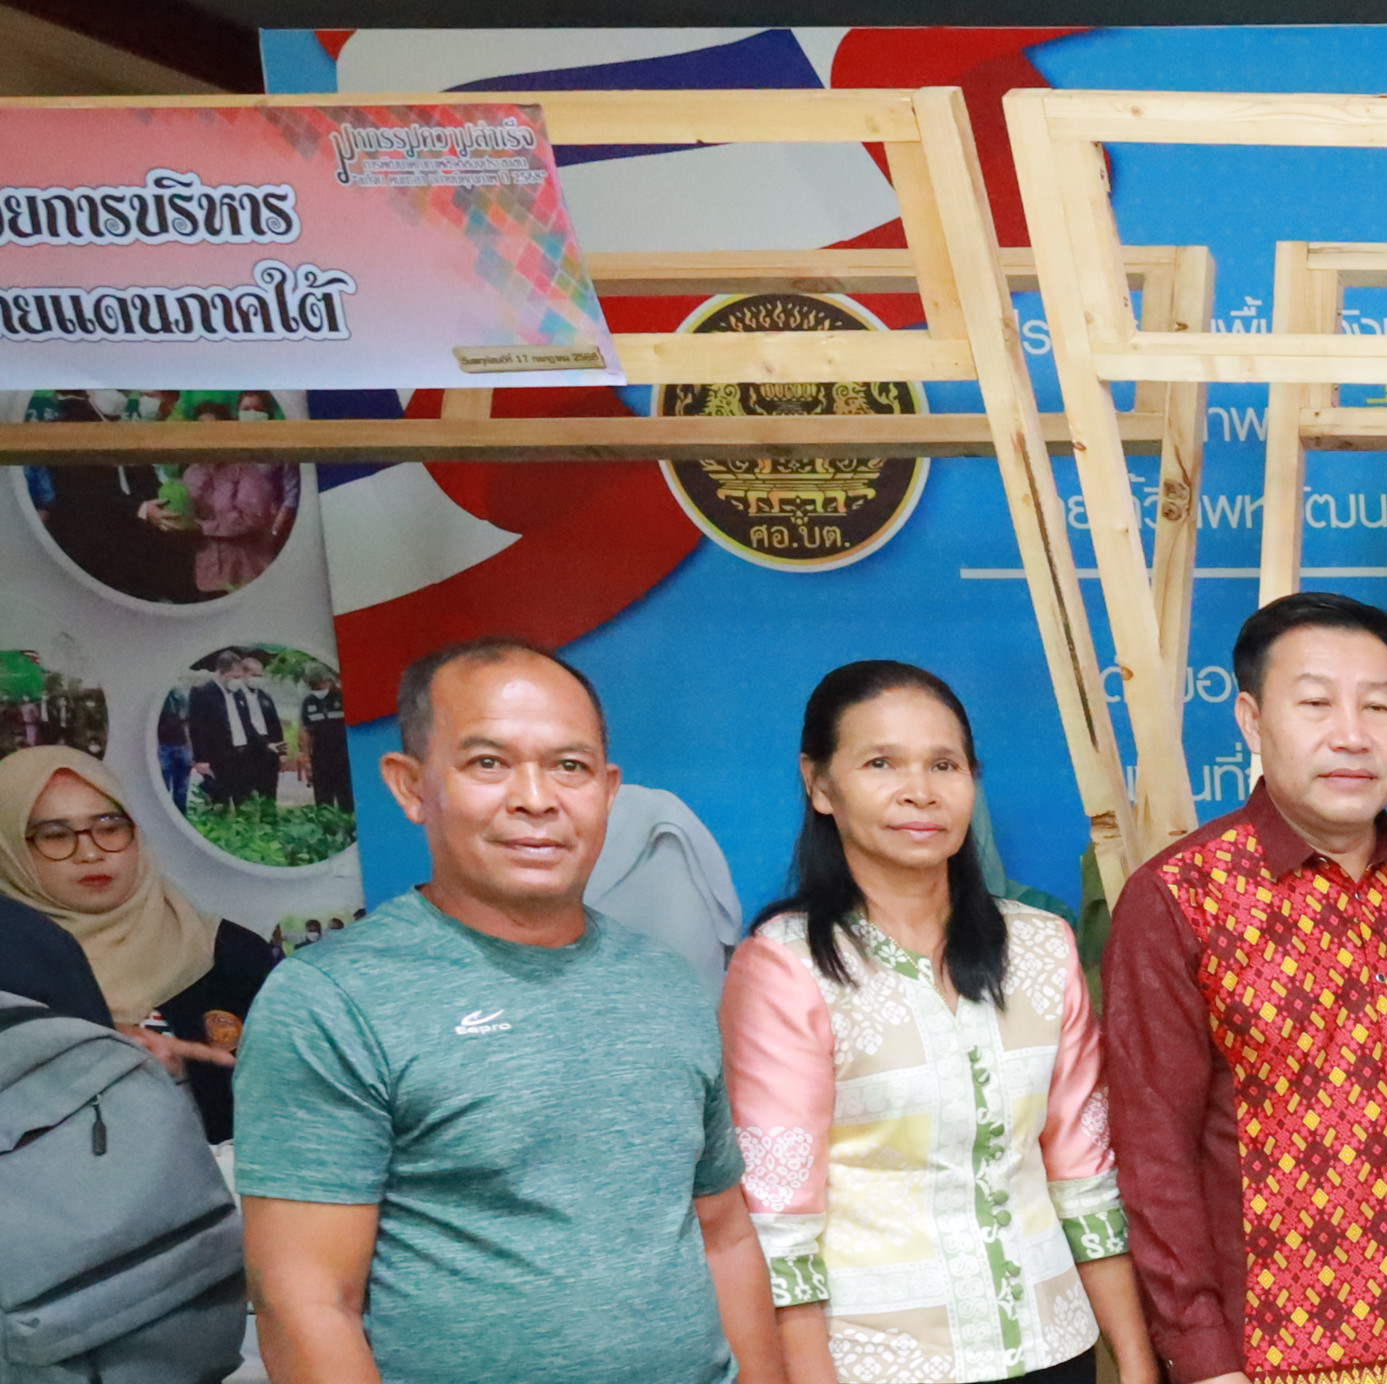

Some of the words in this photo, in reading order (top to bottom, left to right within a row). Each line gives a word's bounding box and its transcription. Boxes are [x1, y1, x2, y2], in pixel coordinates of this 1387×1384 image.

[0, 177, 294, 237] ยการบริหาร
[750, 525, 850, 548] ศอ.บต.
